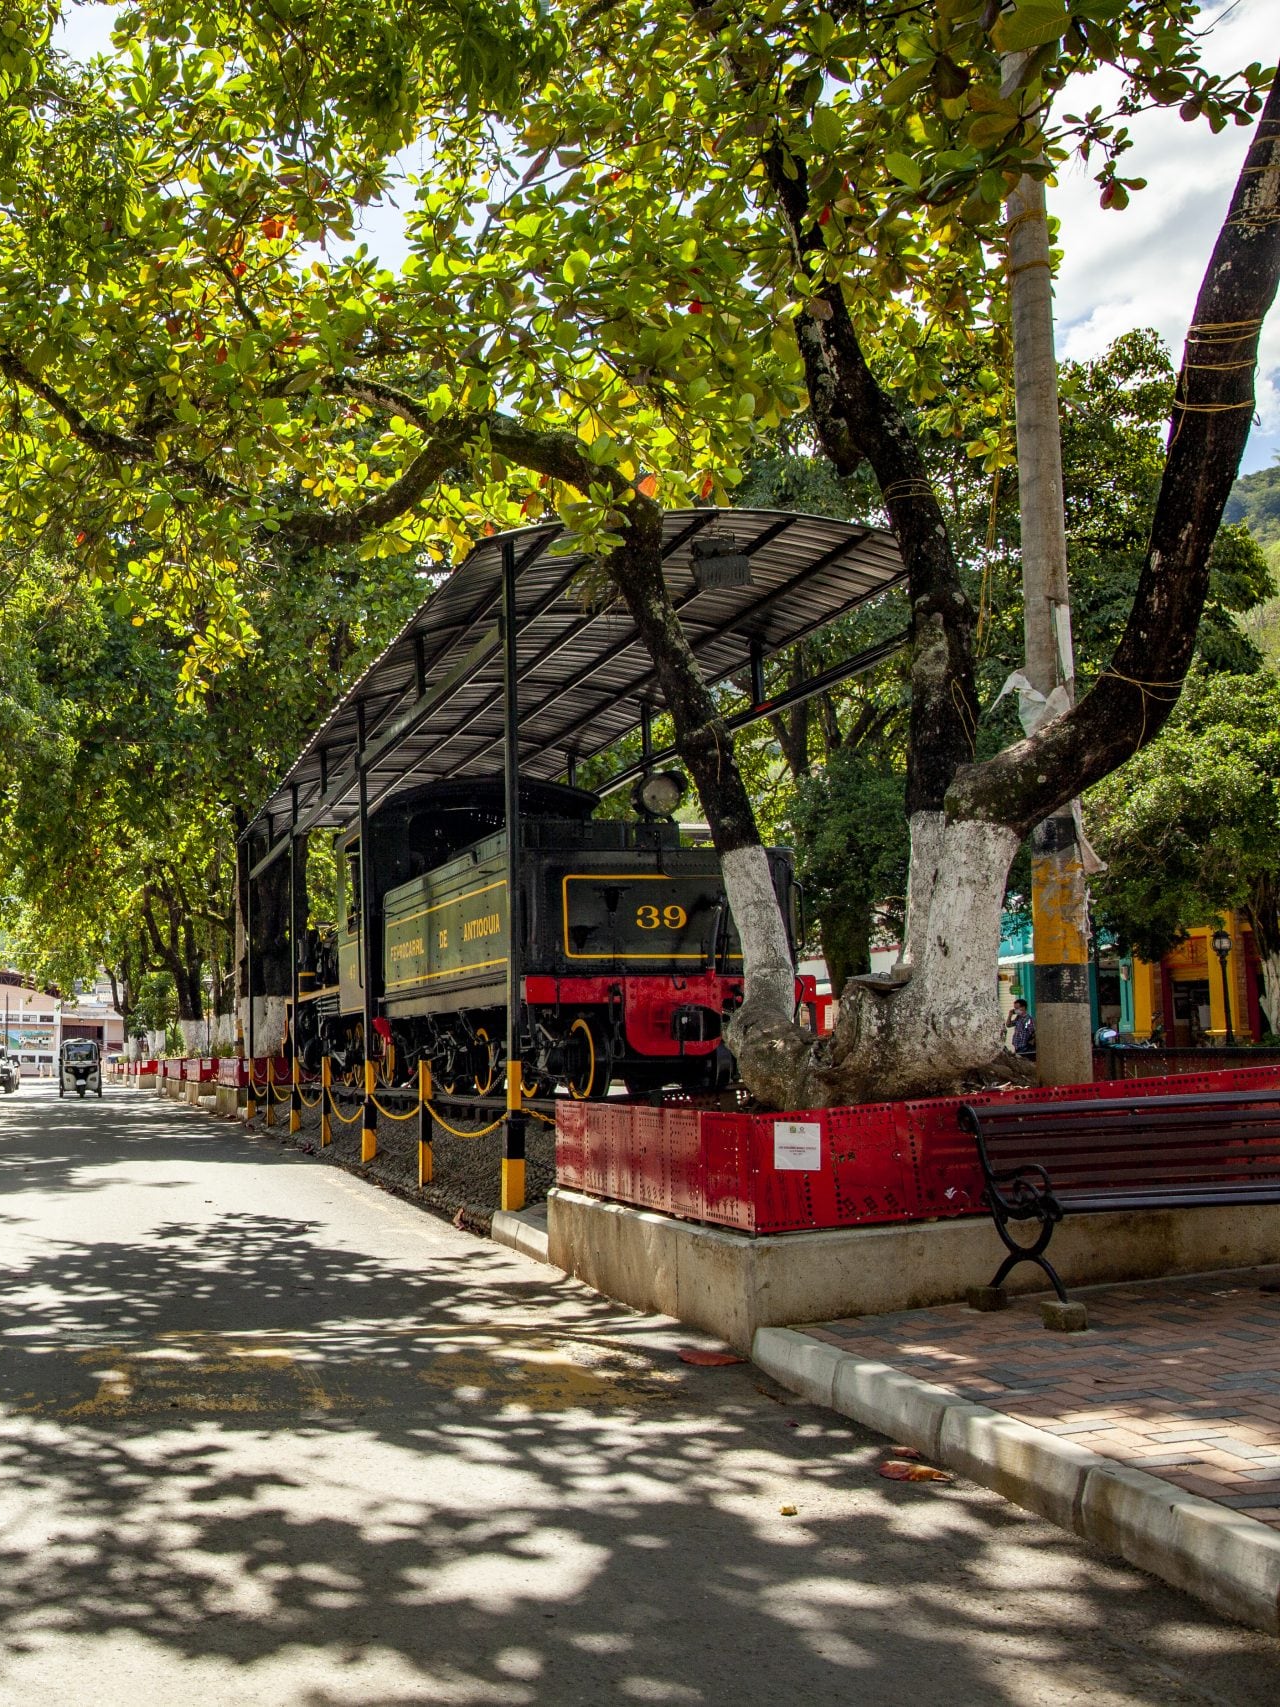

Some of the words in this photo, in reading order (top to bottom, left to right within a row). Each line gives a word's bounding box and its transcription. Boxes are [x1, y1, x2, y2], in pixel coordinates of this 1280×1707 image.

[439, 929, 449, 949] DE
[463, 913, 500, 942] ANTIOQUIA
[636, 905, 687, 929] 39
